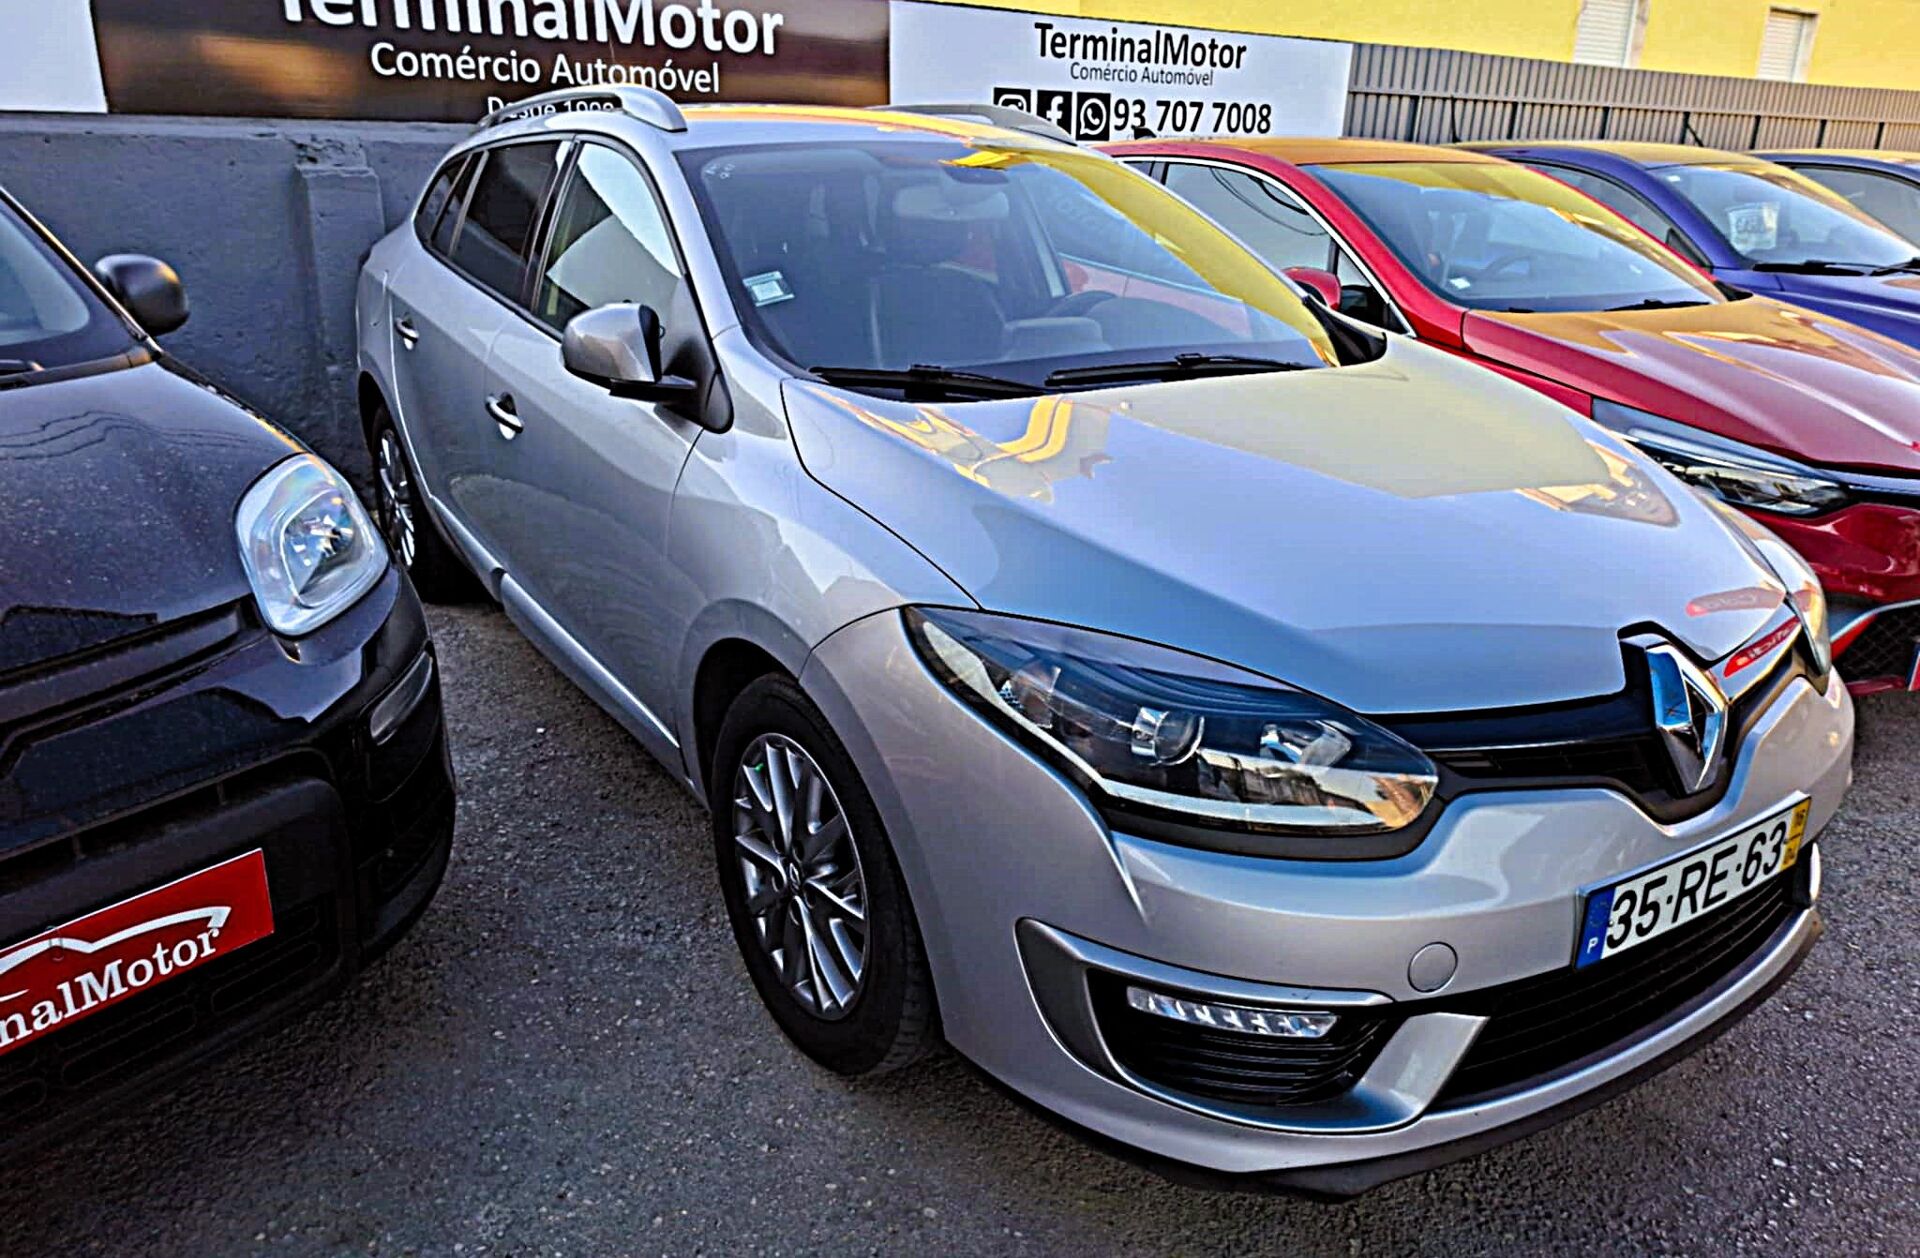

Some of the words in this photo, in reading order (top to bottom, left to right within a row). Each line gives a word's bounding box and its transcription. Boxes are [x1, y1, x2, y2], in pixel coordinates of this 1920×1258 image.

[1034, 22, 1248, 69] TerminalMotor
[371, 42, 541, 83] Comércio
[551, 54, 720, 93] Automóvel
[1070, 62, 1138, 83] Comércio
[1141, 66, 1214, 86] Automóvel
[1114, 98, 1147, 131] 93
[1156, 100, 1204, 132] 707
[1212, 102, 1272, 134] 7008
[1587, 937, 1599, 954] P
